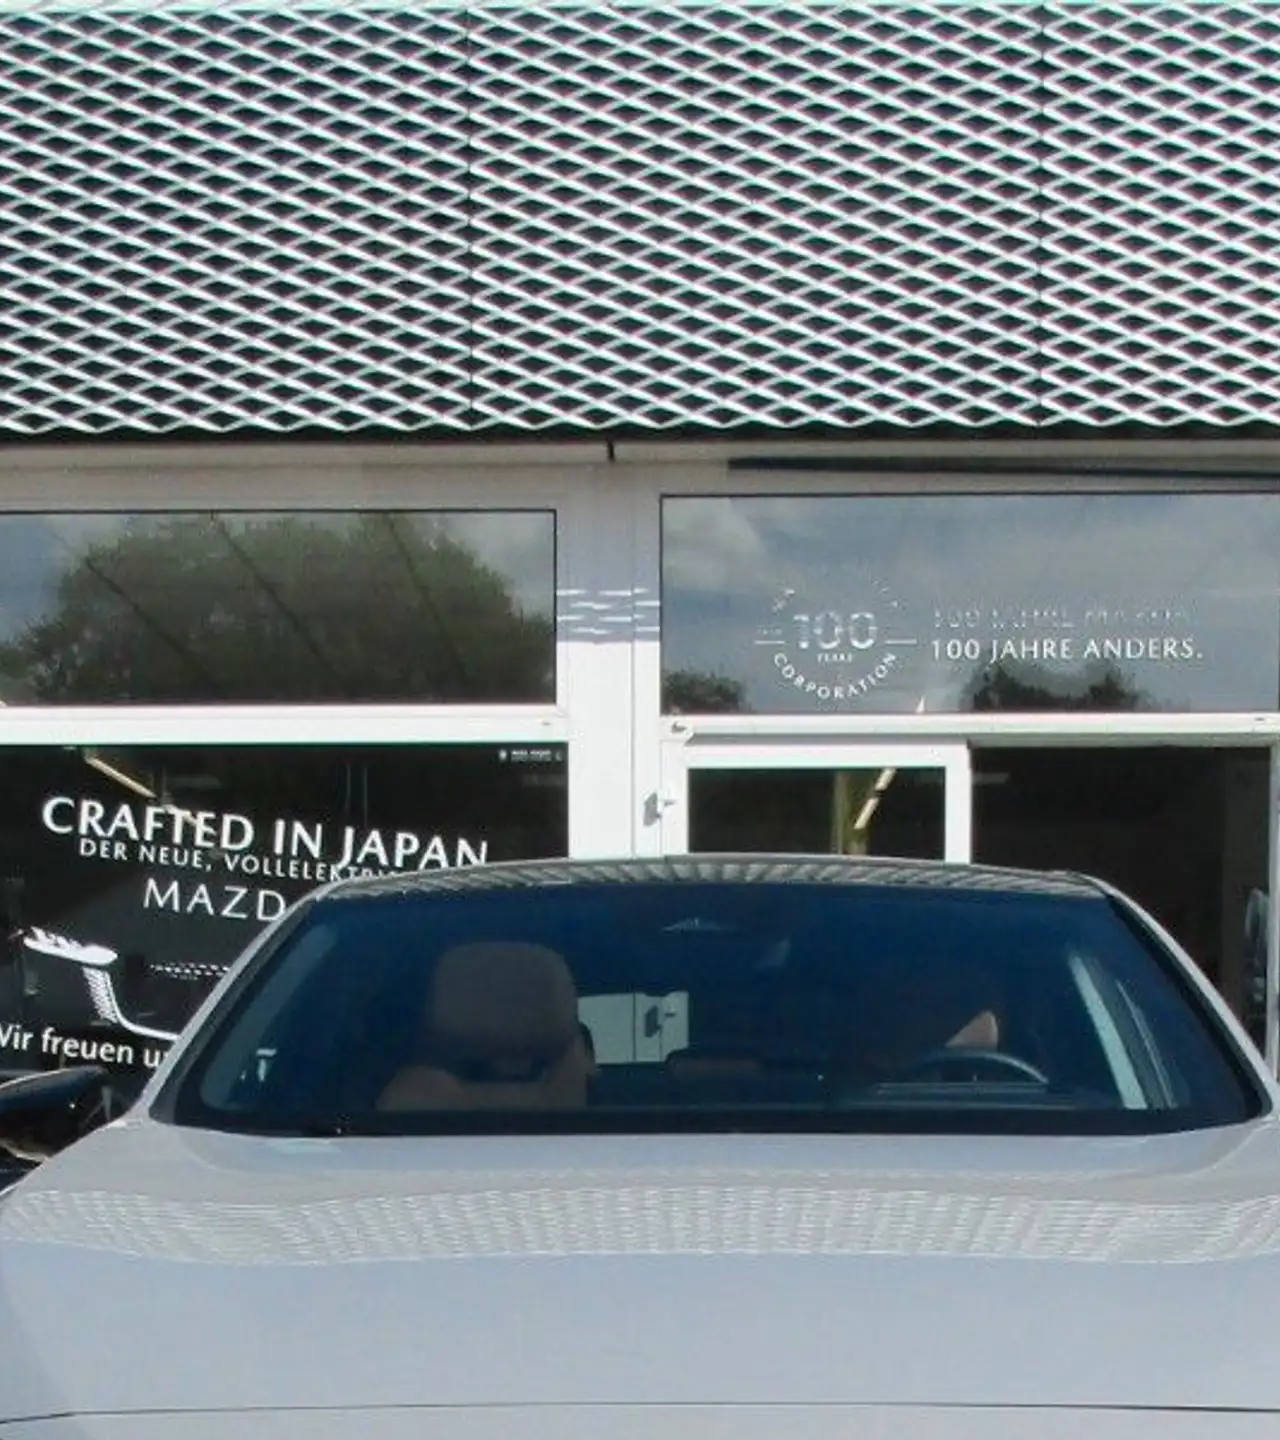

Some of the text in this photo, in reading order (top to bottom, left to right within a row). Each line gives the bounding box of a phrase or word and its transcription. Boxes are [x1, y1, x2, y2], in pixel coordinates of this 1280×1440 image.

[931, 637, 1204, 663] 100 JAHRE ANDERS.
[773, 652, 897, 699] CORPORATION
[42, 796, 488, 870] CRAFTED IN JAPAN
[79, 838, 128, 861] DER
[138, 845, 212, 871] NEUE,
[143, 877, 288, 921] MAZD
[41, 1027, 133, 1064] freuen
